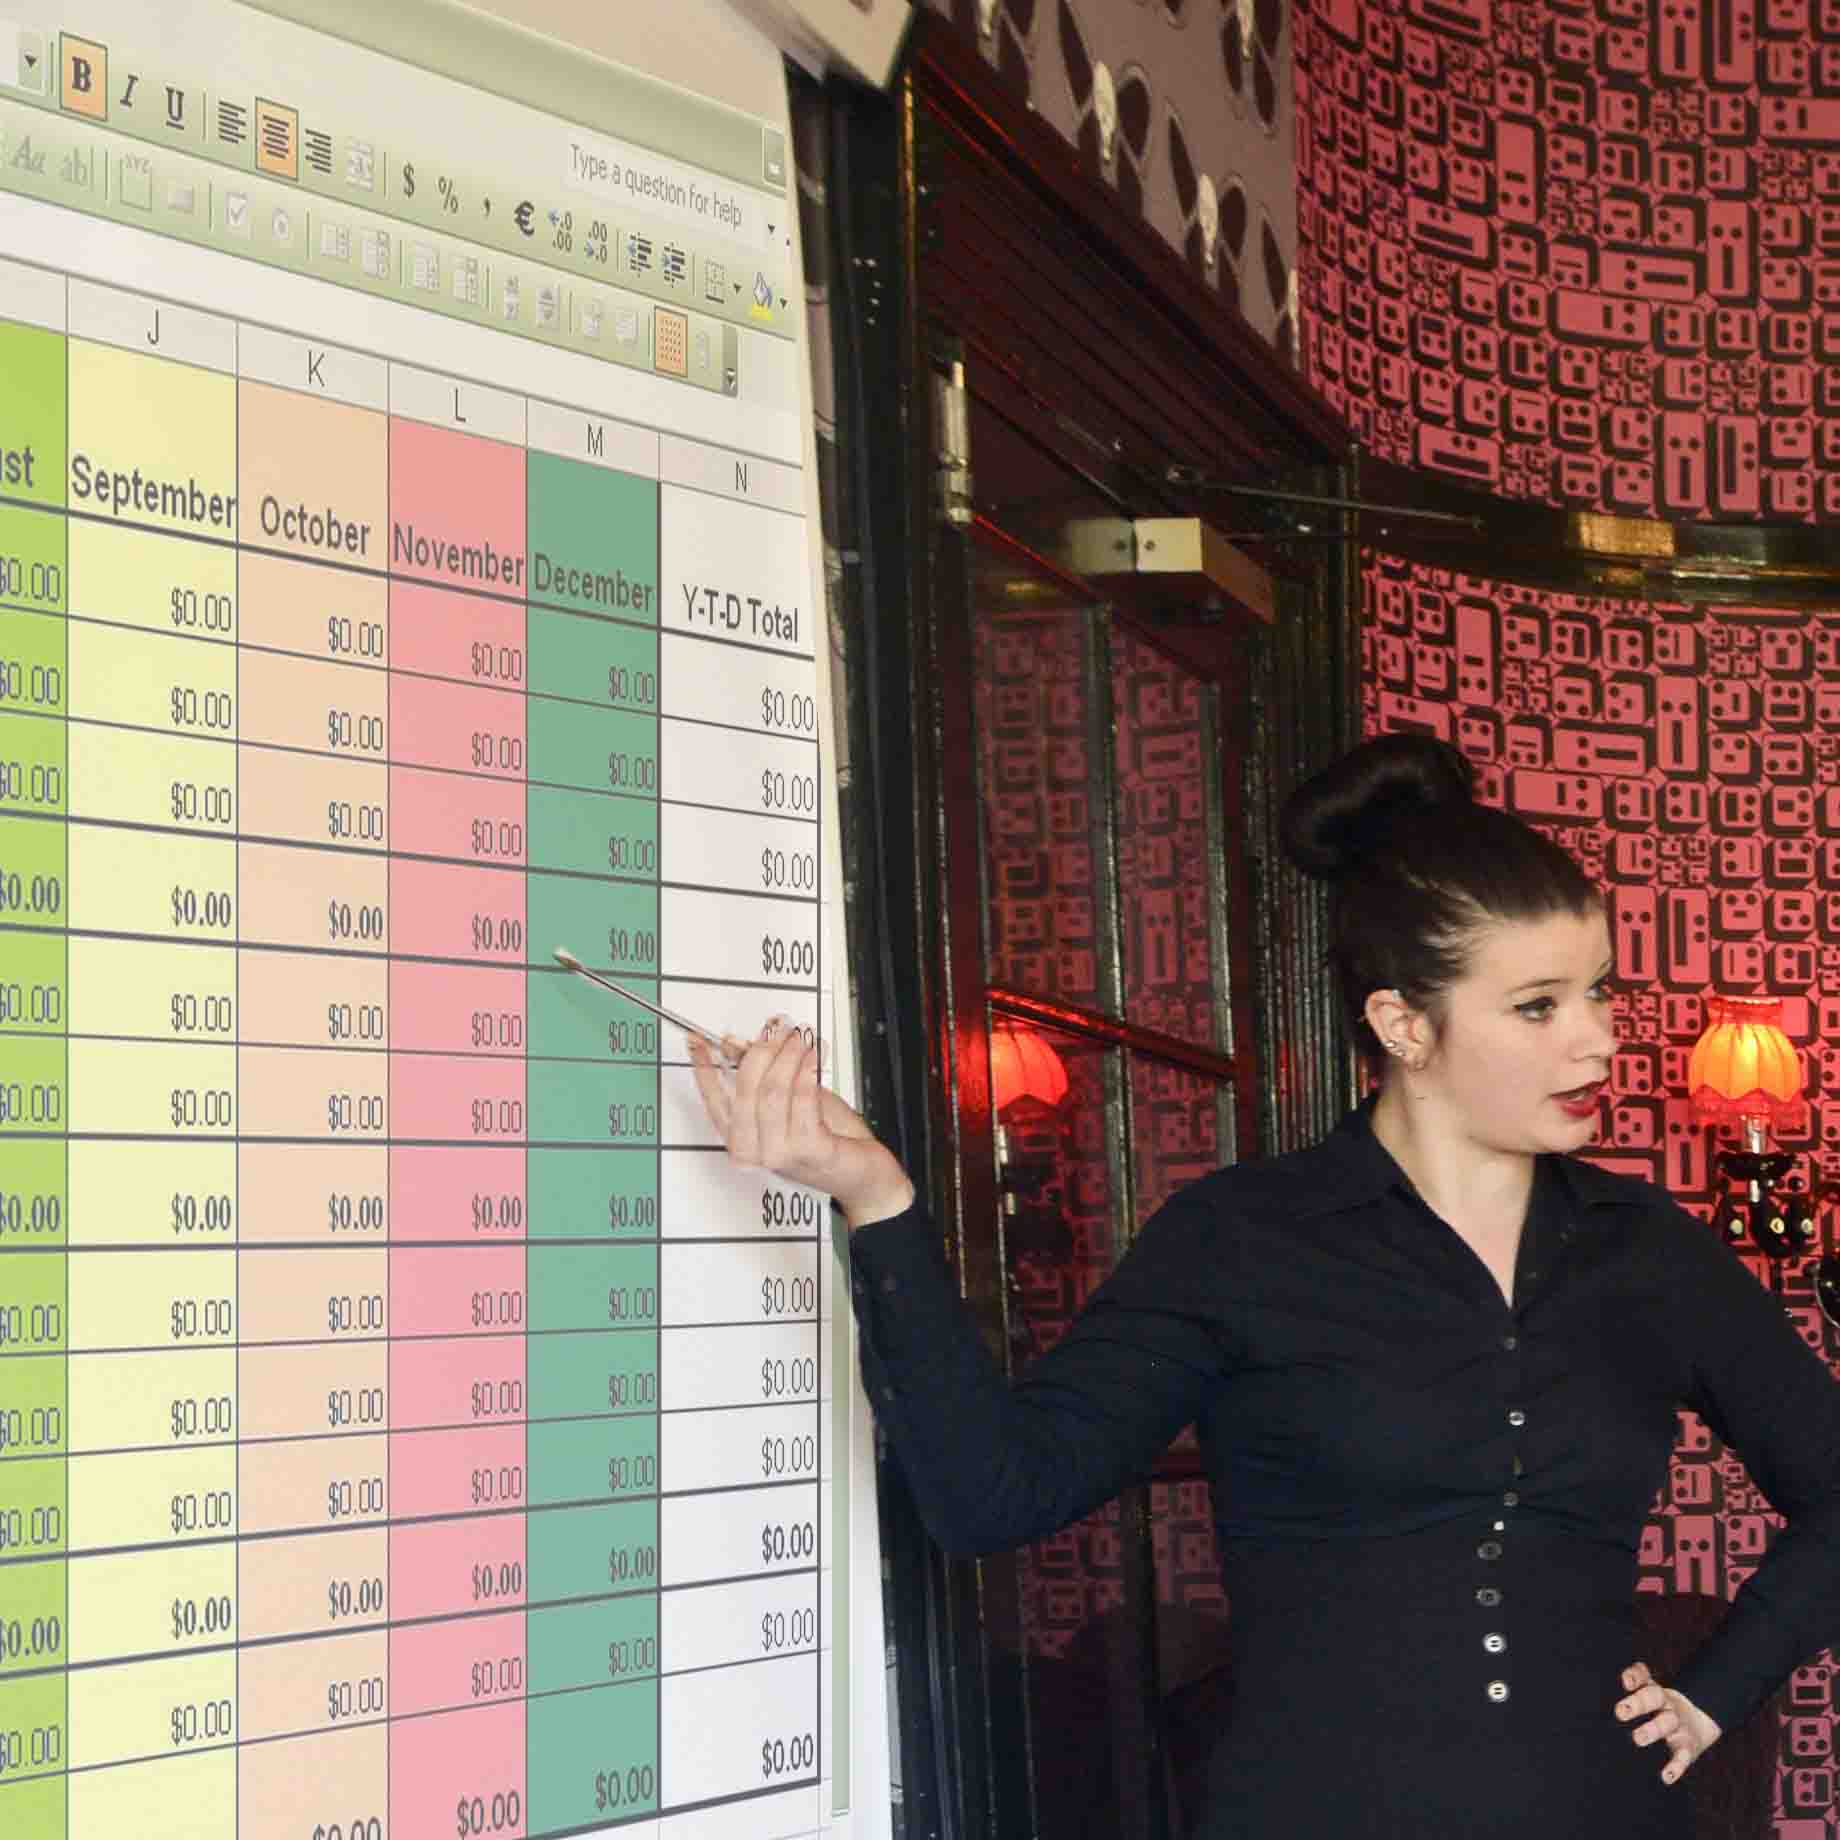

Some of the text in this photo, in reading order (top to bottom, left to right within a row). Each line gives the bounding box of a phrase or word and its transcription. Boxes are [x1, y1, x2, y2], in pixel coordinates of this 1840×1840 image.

[570, 143, 743, 228] Type a question for help
[147, 309, 160, 345] J
[307, 350, 326, 387] K
[454, 389, 467, 423] L
[587, 424, 605, 458] M
[71, 455, 237, 529] September
[735, 461, 748, 492] N
[260, 496, 371, 556] October
[393, 522, 525, 588] November
[534, 552, 655, 613] December
[682, 582, 799, 643] Y-T-D Total
[171, 587, 232, 632] $0.00
[328, 616, 383, 659] $0.00
[472, 642, 522, 682] $0.00
[609, 666, 655, 704] $0.00
[762, 689, 814, 732] $0.00
[171, 686, 231, 730] $0.00
[328, 710, 383, 752] $0.00
[472, 732, 522, 771] $0.00
[609, 753, 655, 790] $0.00
[761, 768, 814, 812] $0.00
[171, 781, 232, 824] $0.00
[328, 801, 383, 842] $0.00
[472, 819, 522, 856] $0.00
[609, 837, 655, 872] $0.00
[762, 847, 814, 890] $0.00
[171, 885, 231, 928] $0.00
[329, 900, 383, 941] $0.00
[472, 914, 521, 952] $0.00
[610, 928, 655, 963] $0.00
[762, 934, 814, 976] $0.00
[171, 993, 232, 1033] $0.00
[328, 1003, 383, 1040] $0.00
[472, 1012, 522, 1047] $0.00
[609, 1022, 655, 1054] $0.00
[171, 1089, 231, 1128] $0.00
[328, 1094, 383, 1132] $0.00
[472, 1099, 522, 1134] $0.00
[609, 1104, 655, 1136] $0.00
[171, 1193, 231, 1235] $0.00
[329, 1192, 383, 1232] $0.00
[472, 1194, 522, 1231] $0.00
[610, 1196, 655, 1229] $0.00
[762, 1188, 814, 1229] $0.00
[171, 1299, 231, 1340] $0.00
[328, 1295, 383, 1334] $0.00
[472, 1291, 522, 1327] $0.00
[609, 1288, 655, 1320] $0.00
[762, 1276, 814, 1317] $0.00
[171, 1397, 231, 1440] $0.00
[328, 1388, 383, 1428] $0.00
[472, 1380, 522, 1419] $0.00
[609, 1373, 655, 1408] $0.00
[762, 1357, 814, 1398] $0.00
[171, 1491, 231, 1535] $0.00
[328, 1478, 383, 1519] $0.00
[472, 1466, 522, 1504] $0.00
[609, 1456, 655, 1492] $0.00
[762, 1435, 814, 1475] $0.00
[171, 1596, 232, 1640] $0.00
[329, 1578, 383, 1621] $0.00
[472, 1562, 522, 1601] $0.00
[610, 1546, 655, 1583] $0.00
[762, 1522, 814, 1565] $0.00
[171, 1700, 231, 1747] $0.00
[328, 1677, 383, 1721] $0.00
[472, 1657, 522, 1697] $0.00
[609, 1637, 655, 1675] $0.00
[762, 1608, 814, 1652] $0.00
[457, 1790, 520, 1836] $0.00
[596, 1765, 654, 1808] $0.00
[762, 1733, 814, 1778] $0.00
